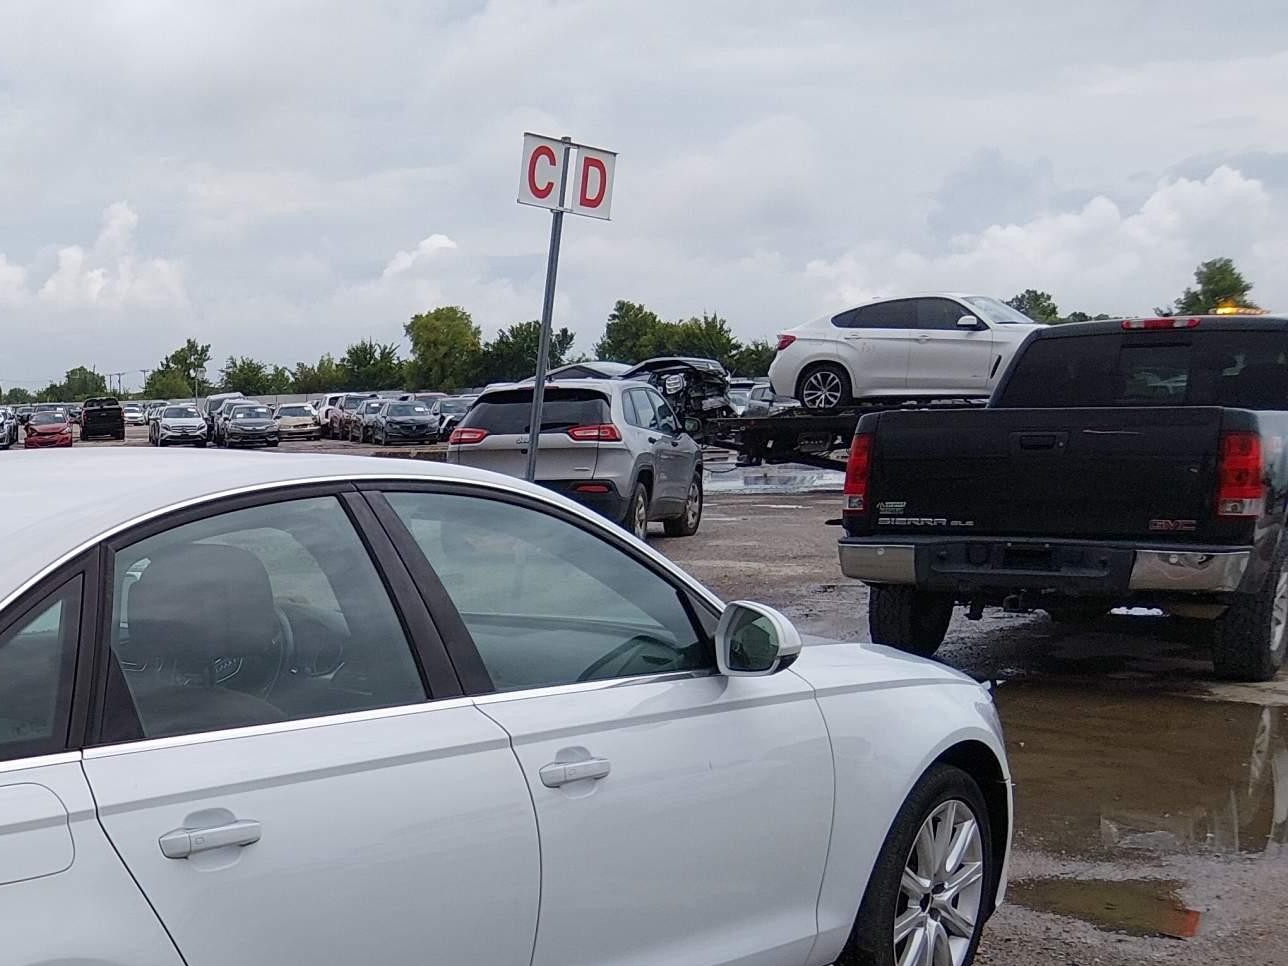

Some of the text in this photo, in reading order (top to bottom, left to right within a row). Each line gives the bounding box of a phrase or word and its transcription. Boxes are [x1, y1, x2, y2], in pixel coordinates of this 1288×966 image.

[528, 145, 607, 209] C D
[877, 517, 947, 526] SIERRA
[1149, 519, 1197, 531] GMC
